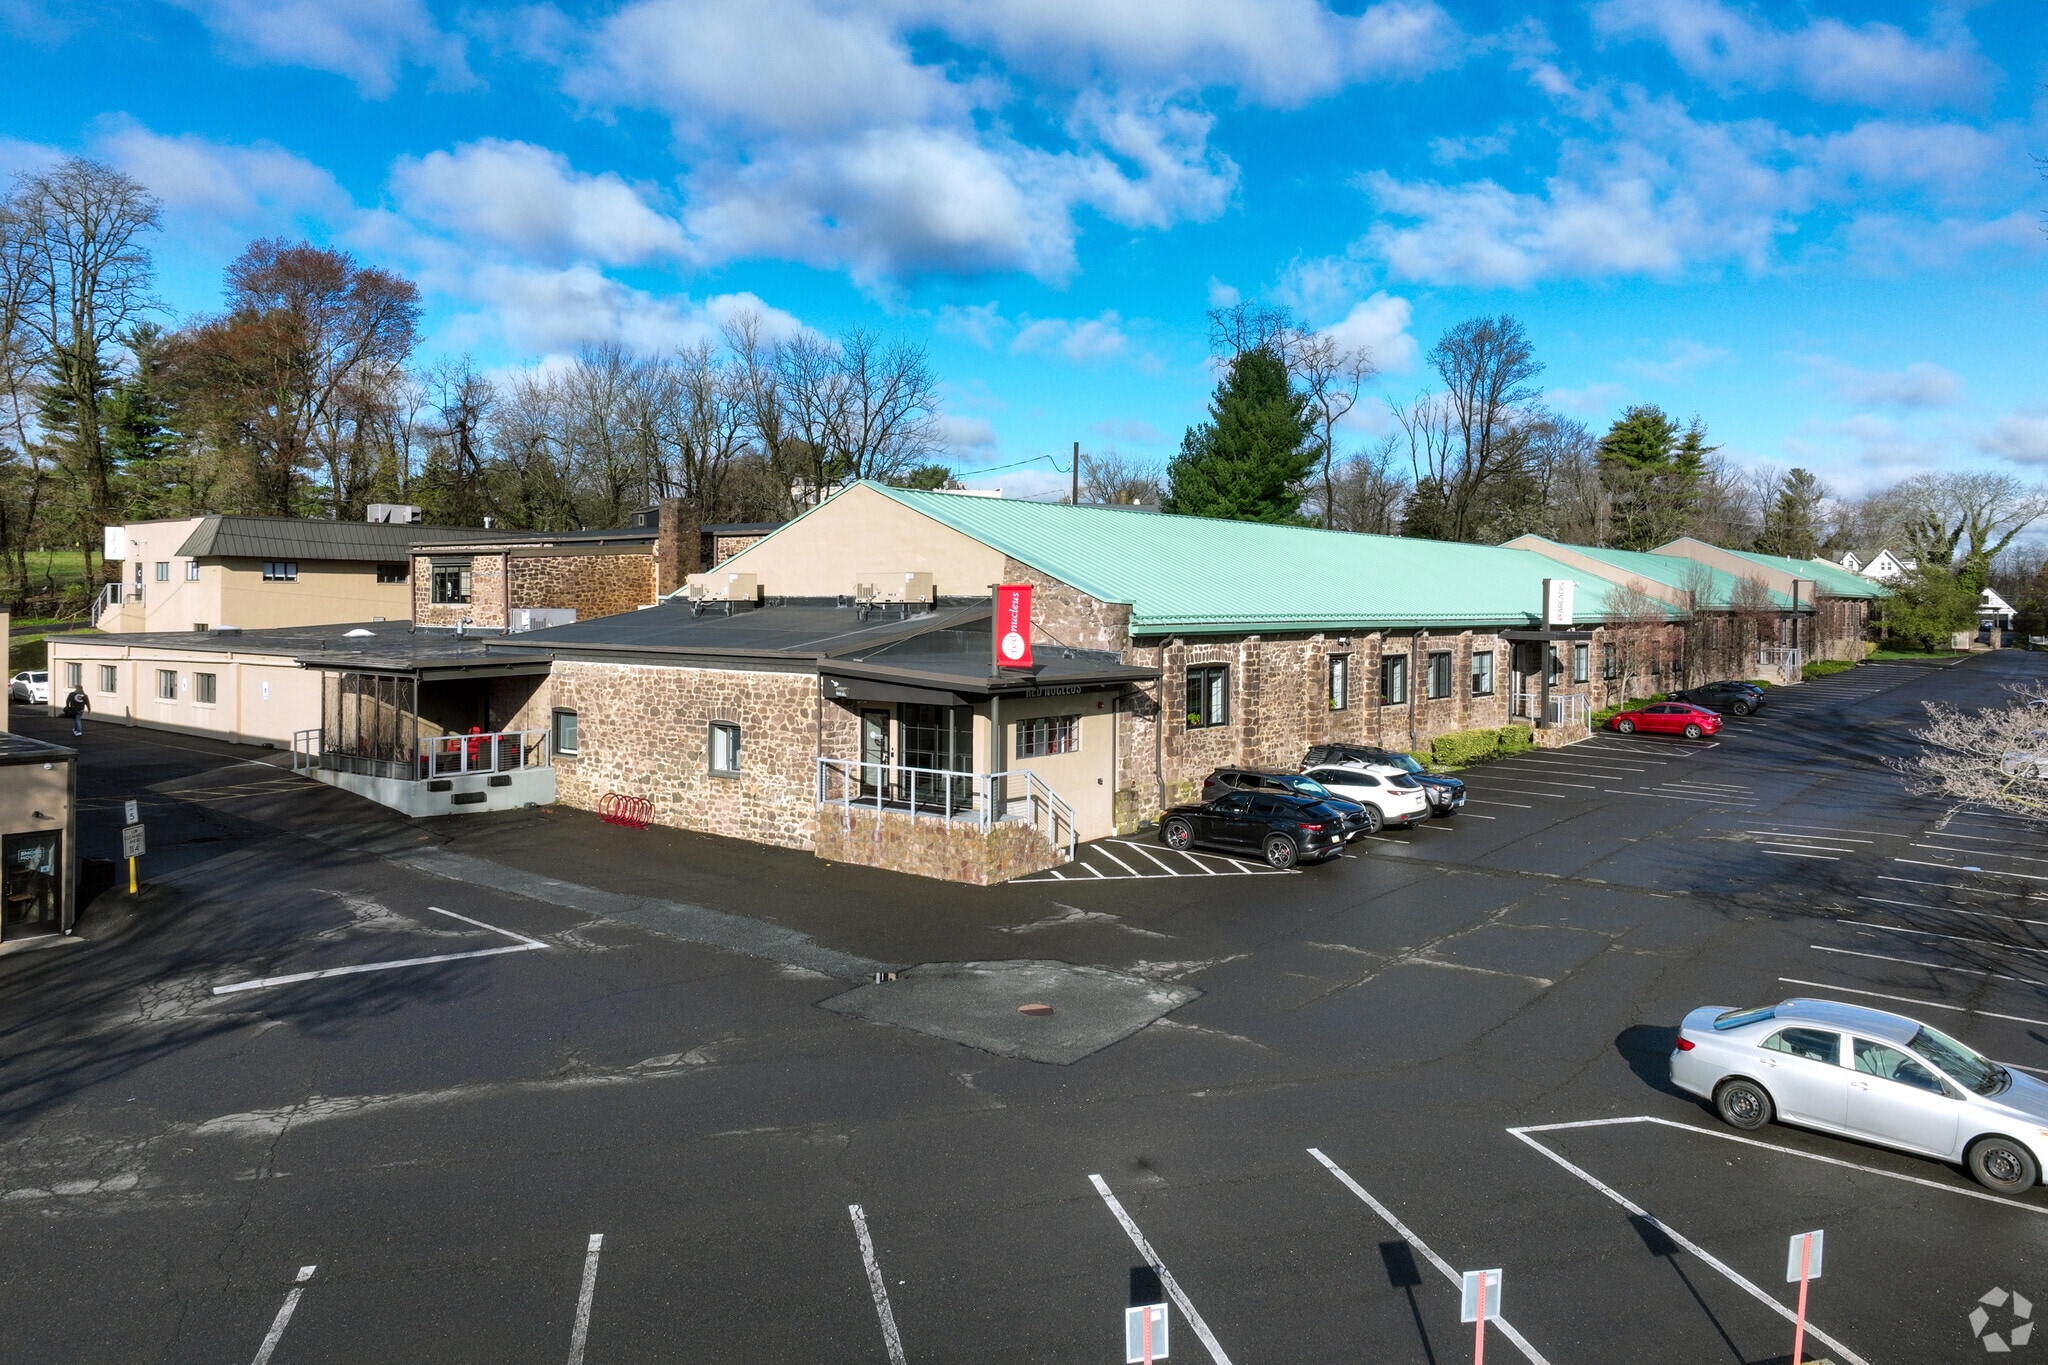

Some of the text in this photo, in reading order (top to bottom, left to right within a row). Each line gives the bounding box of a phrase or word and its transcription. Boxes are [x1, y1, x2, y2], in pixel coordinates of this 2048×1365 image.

[1009, 592, 1020, 633] nucleus
[1044, 686, 1082, 697] NUCLEUS
[129, 812, 135, 821] 5
